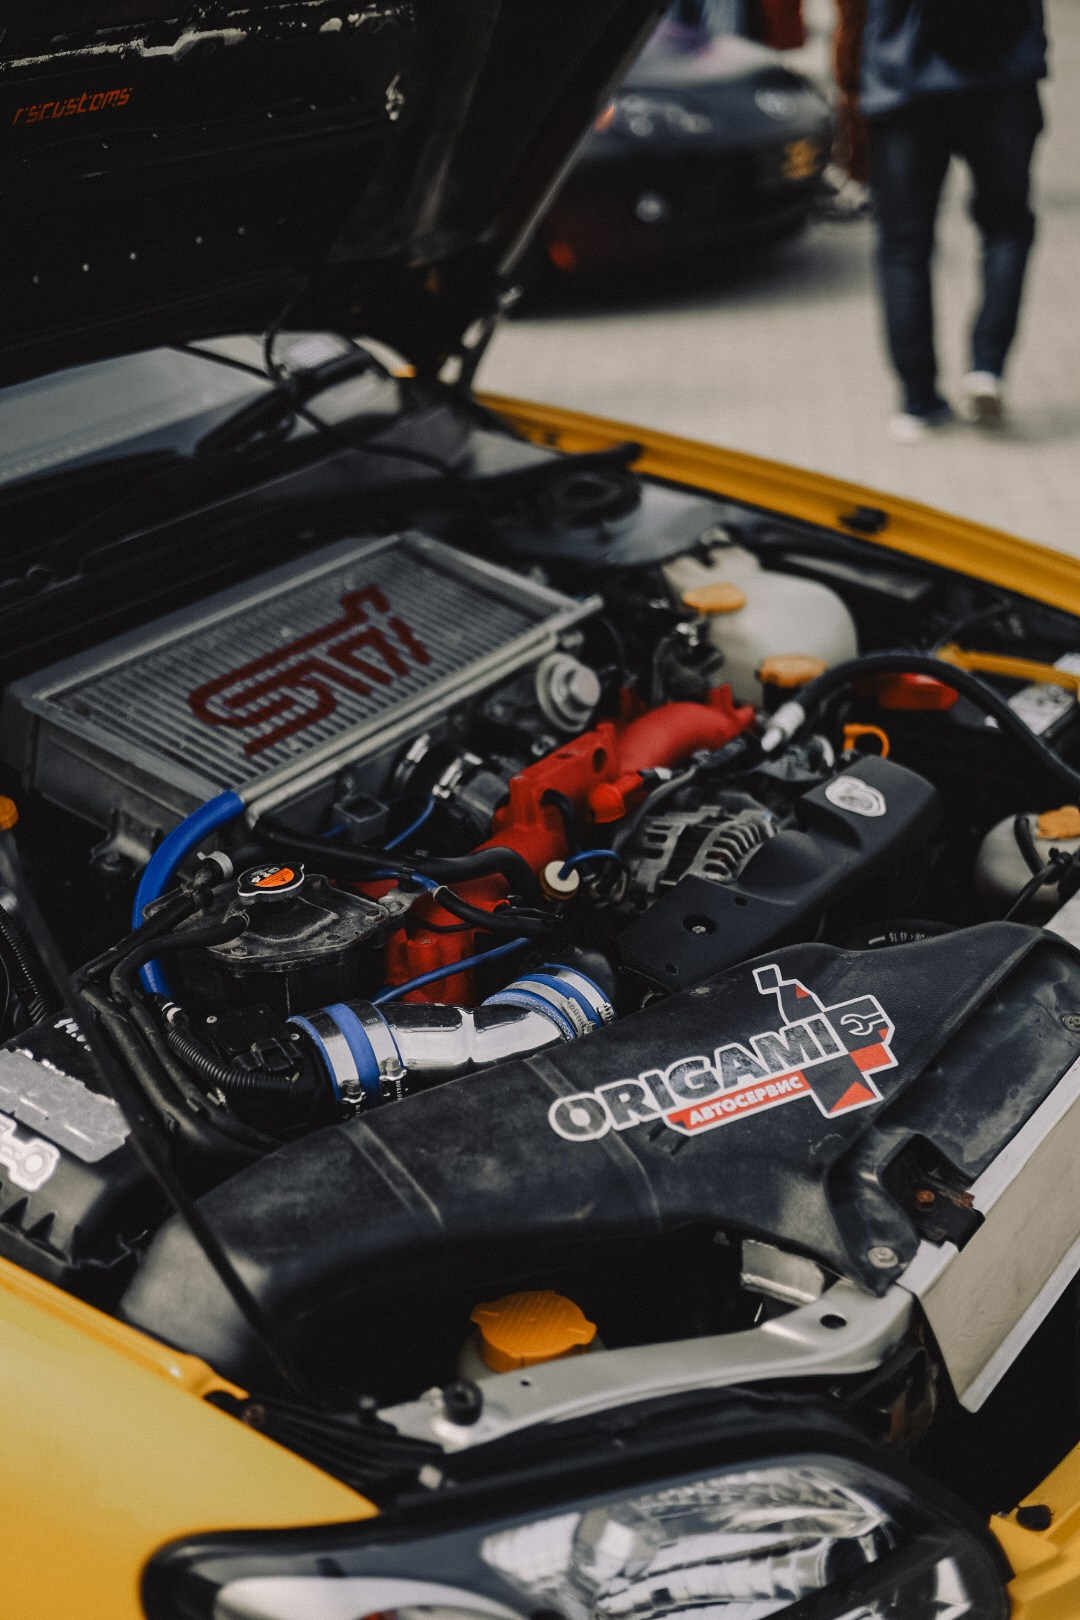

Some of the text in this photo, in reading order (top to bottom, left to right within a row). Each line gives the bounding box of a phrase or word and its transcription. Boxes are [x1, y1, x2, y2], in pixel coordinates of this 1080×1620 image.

[12, 87, 133, 126] rscustoms
[548, 1016, 846, 1141] ORIGAMI
[689, 1074, 805, 1127] АВТОСЕРВИС
